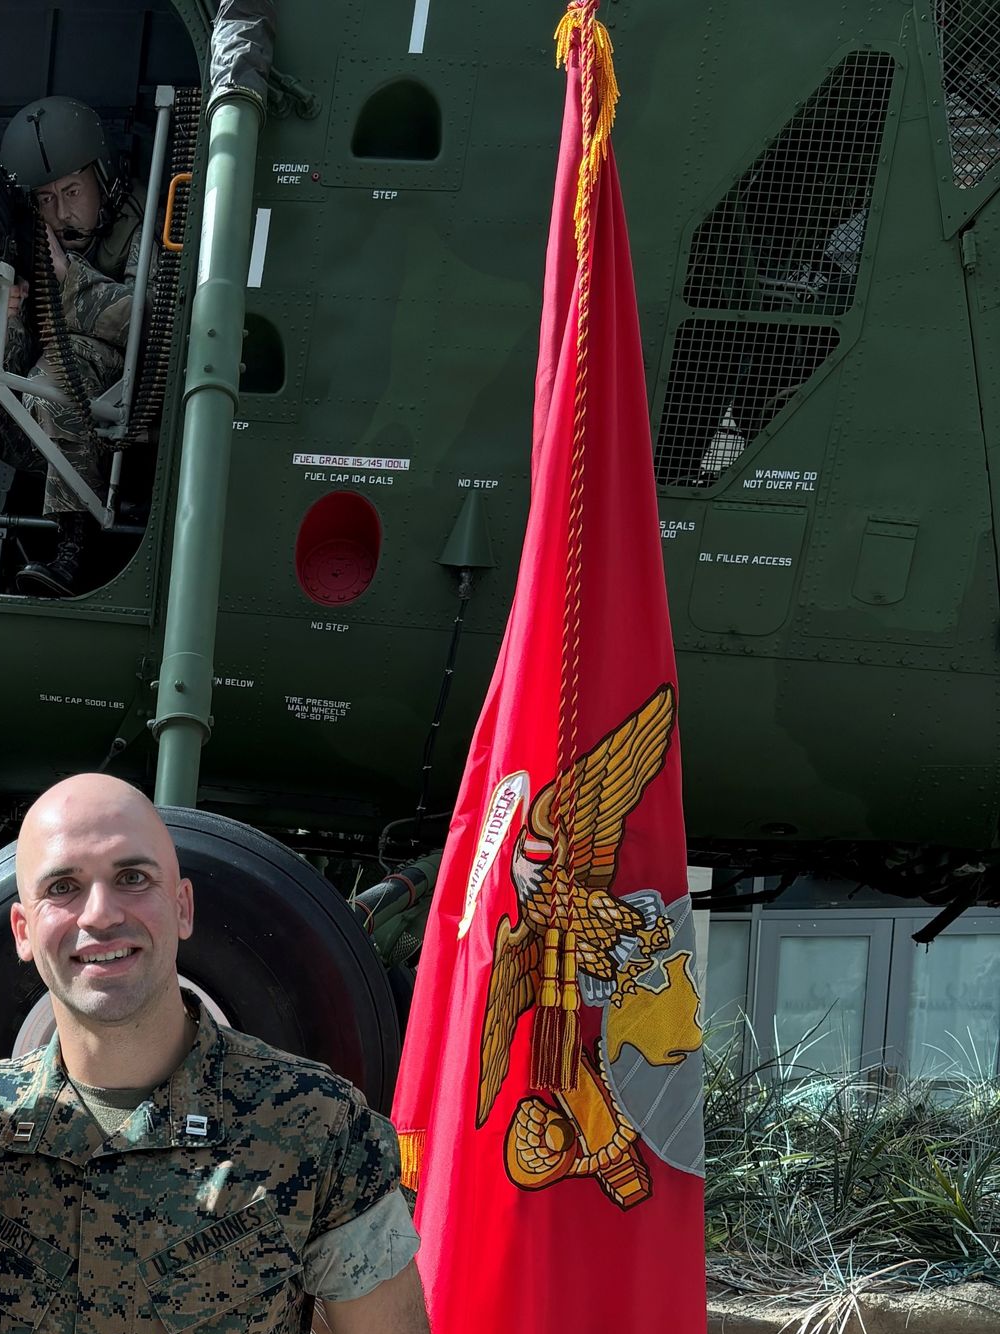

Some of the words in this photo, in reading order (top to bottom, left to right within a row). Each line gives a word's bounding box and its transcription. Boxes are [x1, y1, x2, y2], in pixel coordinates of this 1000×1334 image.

[272, 163, 310, 173] GROUND
[277, 175, 301, 185] HERE
[372, 190, 398, 200] STEP
[294, 454, 316, 464] FUEL
[319, 456, 349, 466] GRADE
[352, 458, 383, 468] 115/145
[384, 459, 409, 469] 100LL
[304, 472, 327, 482] FUEL
[330, 473, 349, 483] CAP
[352, 474, 366, 484] 104
[368, 476, 394, 485] GALS
[755, 469, 800, 480] WARNING
[803, 472, 818, 481] DO
[457, 478, 471, 488] NO
[473, 479, 499, 489] STEP
[743, 480, 762, 489] NOT
[766, 480, 792, 490] OVER
[795, 481, 815, 491] FILL
[669, 521, 695, 531] GALS
[699, 552, 714, 562] OIL
[716, 553, 749, 564] FILLER
[751, 555, 793, 567] ACCESS
[310, 621, 323, 630] NO
[325, 622, 349, 632] STEP
[225, 678, 255, 688] BELOW
[39, 694, 63, 703] SLING
[65, 696, 82, 704] CAP
[84, 698, 107, 708] 5000
[108, 701, 125, 709] LBS
[284, 695, 304, 705] TIRE
[306, 698, 352, 710] PRESSURE
[287, 704, 309, 713] MAIN
[311, 706, 347, 716] WHEELS
[295, 711, 321, 721] 45-50
[323, 714, 338, 723] PSI
[151, 1248, 187, 1277] U.S.
[183, 1206, 262, 1260] MARINES
